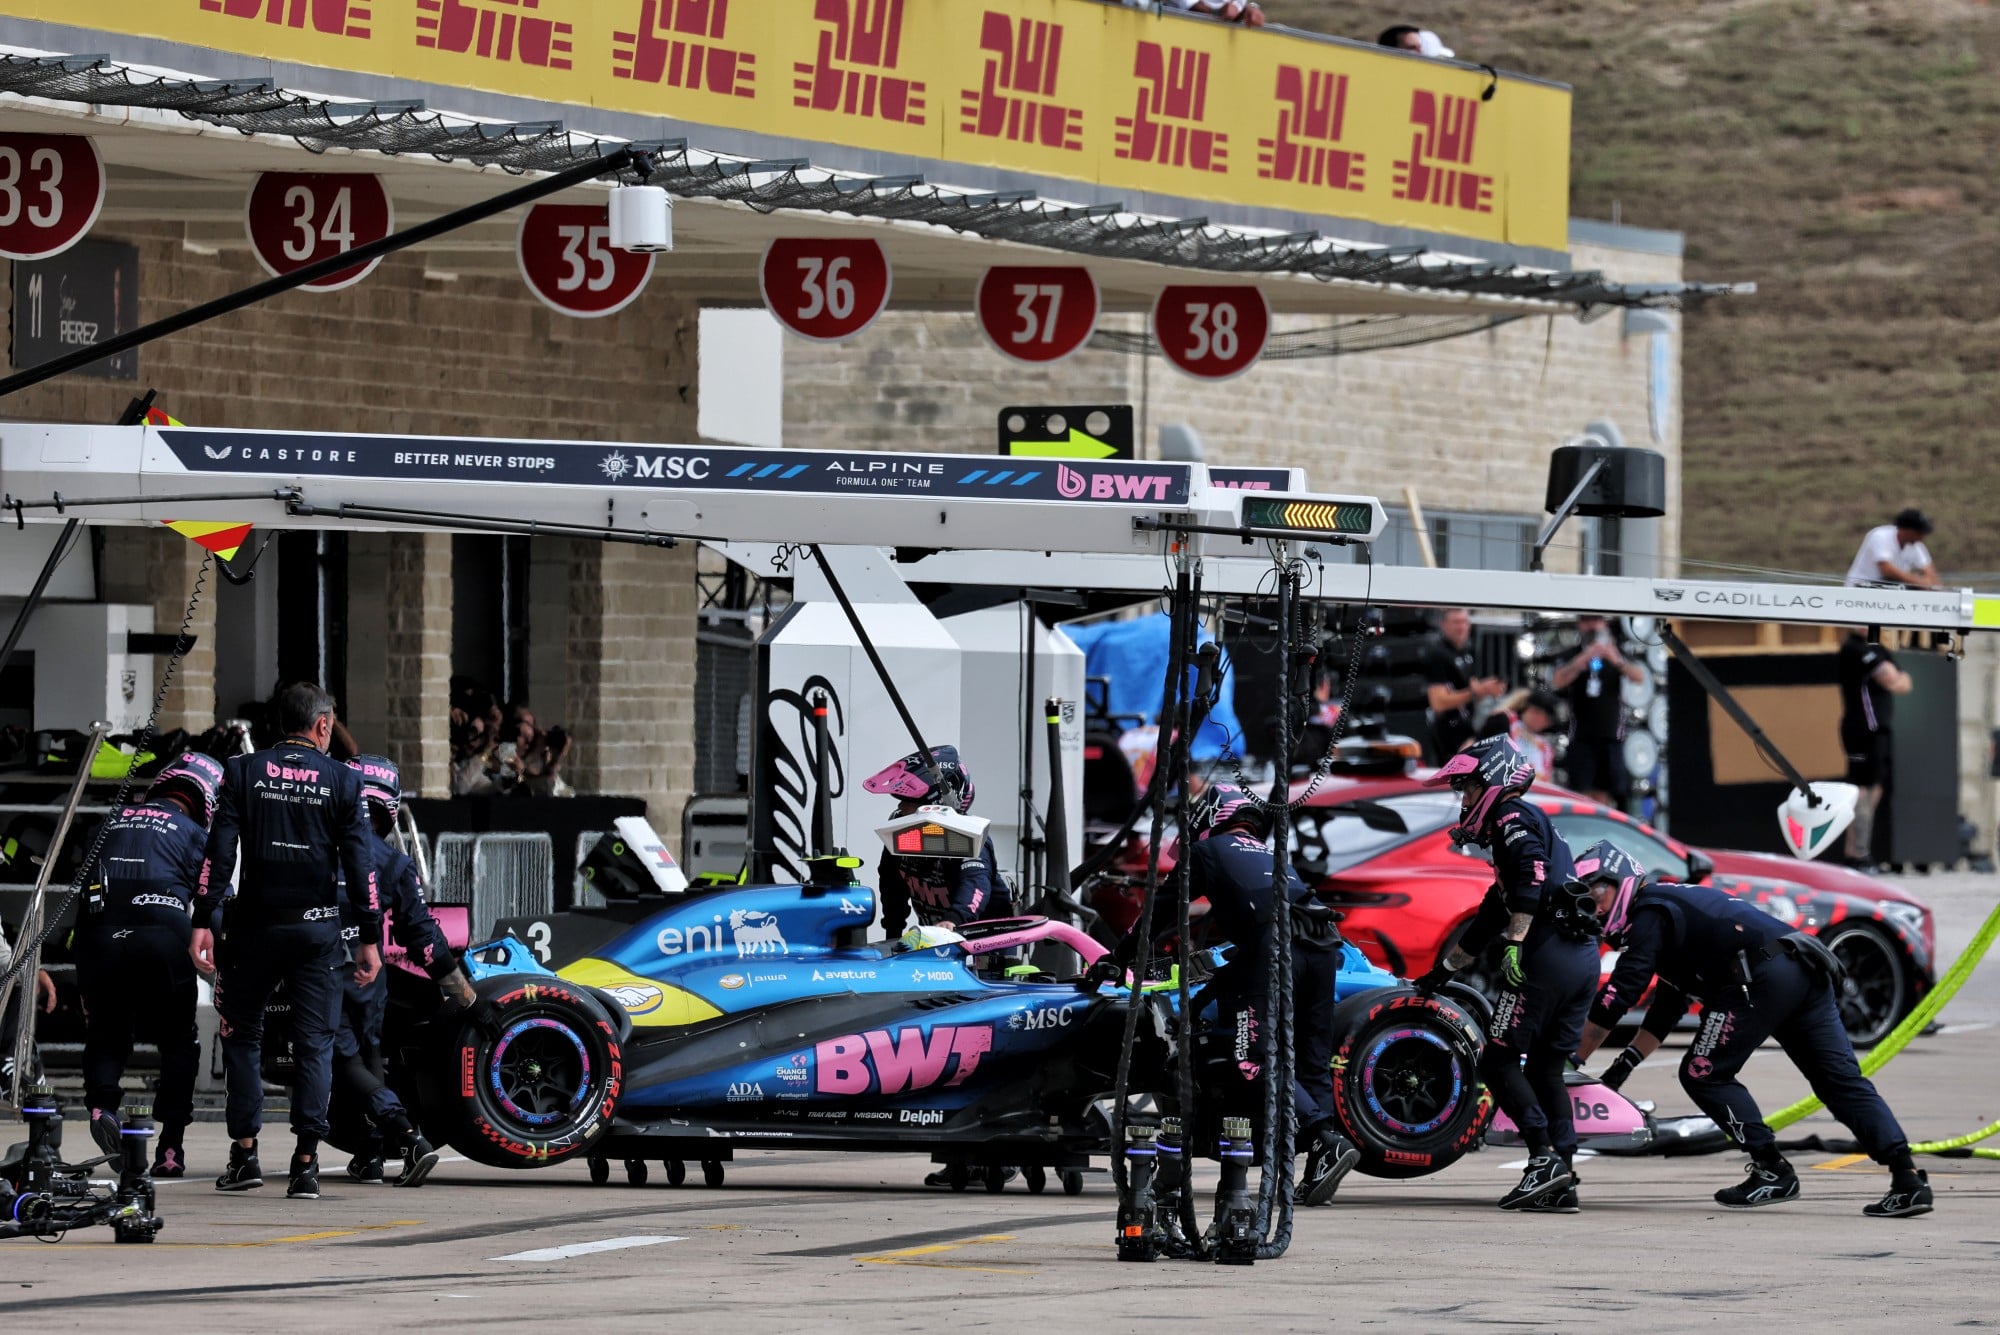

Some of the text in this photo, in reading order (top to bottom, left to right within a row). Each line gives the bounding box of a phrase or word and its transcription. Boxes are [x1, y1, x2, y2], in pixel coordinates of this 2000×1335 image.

[978, 10, 1067, 148] DHL
[1130, 40, 1213, 171] DHL
[1272, 63, 1350, 191] DHL
[1407, 88, 1480, 211] DHL
[0, 147, 63, 229] 33
[282, 185, 355, 260] 34
[557, 225, 616, 292] 35
[796, 256, 856, 320] 36
[28, 273, 42, 338] 11
[1011, 283, 1063, 344] 37
[60, 320, 98, 345] PEREZ
[1184, 302, 1239, 361] 38
[242, 448, 356, 463] CASTORE
[394, 452, 555, 469] BETTER NEVER STOPS
[633, 455, 711, 480] MSC
[825, 460, 944, 475] ALPINE
[836, 476, 877, 486] FORMULA
[907, 478, 931, 488] TEAM
[1090, 474, 1172, 500] BWT
[1694, 590, 1824, 608] CADILLAC
[1835, 599, 1905, 611] FORMULA
[1922, 603, 1961, 614] TEAM
[253, 780, 331, 797] ALPINE
[281, 766, 320, 783] BWT
[363, 765, 396, 783] BWT
[261, 791, 288, 801] FORMULA
[306, 797, 322, 806] TEAM
[657, 914, 723, 956] eni
[754, 974, 788, 982] aiwa
[825, 969, 877, 979] avature
[927, 971, 954, 981] MODO
[1023, 1006, 1073, 1031] MSC
[1368, 1003, 1383, 1021] P
[1388, 996, 1461, 1021] ZERO
[1491, 990, 1510, 1037] CHANGE
[1500, 993, 1517, 1031] WORLD
[1235, 1011, 1245, 1061] CHANGE
[1242, 1010, 1250, 1050] WORLD
[1697, 1011, 1719, 1056] CHANGE
[1707, 1012, 1726, 1049] WORLD
[462, 1046, 475, 1097] PIRELLI
[596, 1021, 622, 1119] P ZERO
[816, 1025, 993, 1096] BWT
[727, 1082, 764, 1096] ADA
[899, 1110, 944, 1126] Delphi
[1573, 1097, 1609, 1121] be
[1384, 1149, 1432, 1166] PIRELLI
